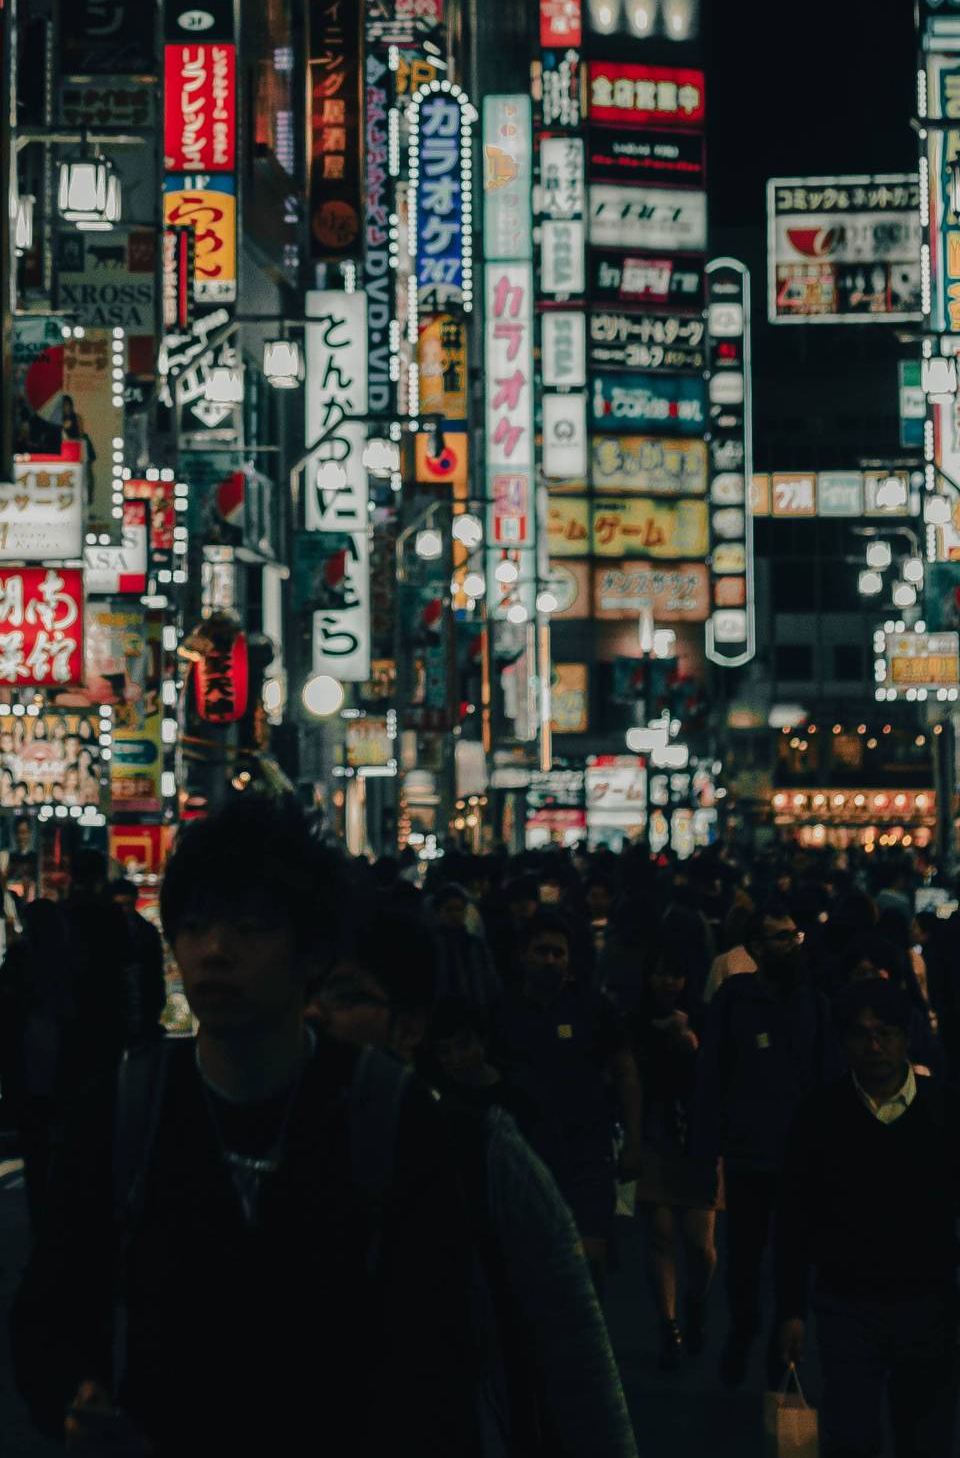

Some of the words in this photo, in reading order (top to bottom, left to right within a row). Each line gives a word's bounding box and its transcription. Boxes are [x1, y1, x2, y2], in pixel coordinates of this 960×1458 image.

[420, 96, 461, 256] カラオケ
[492, 275, 527, 457] カラオケ
